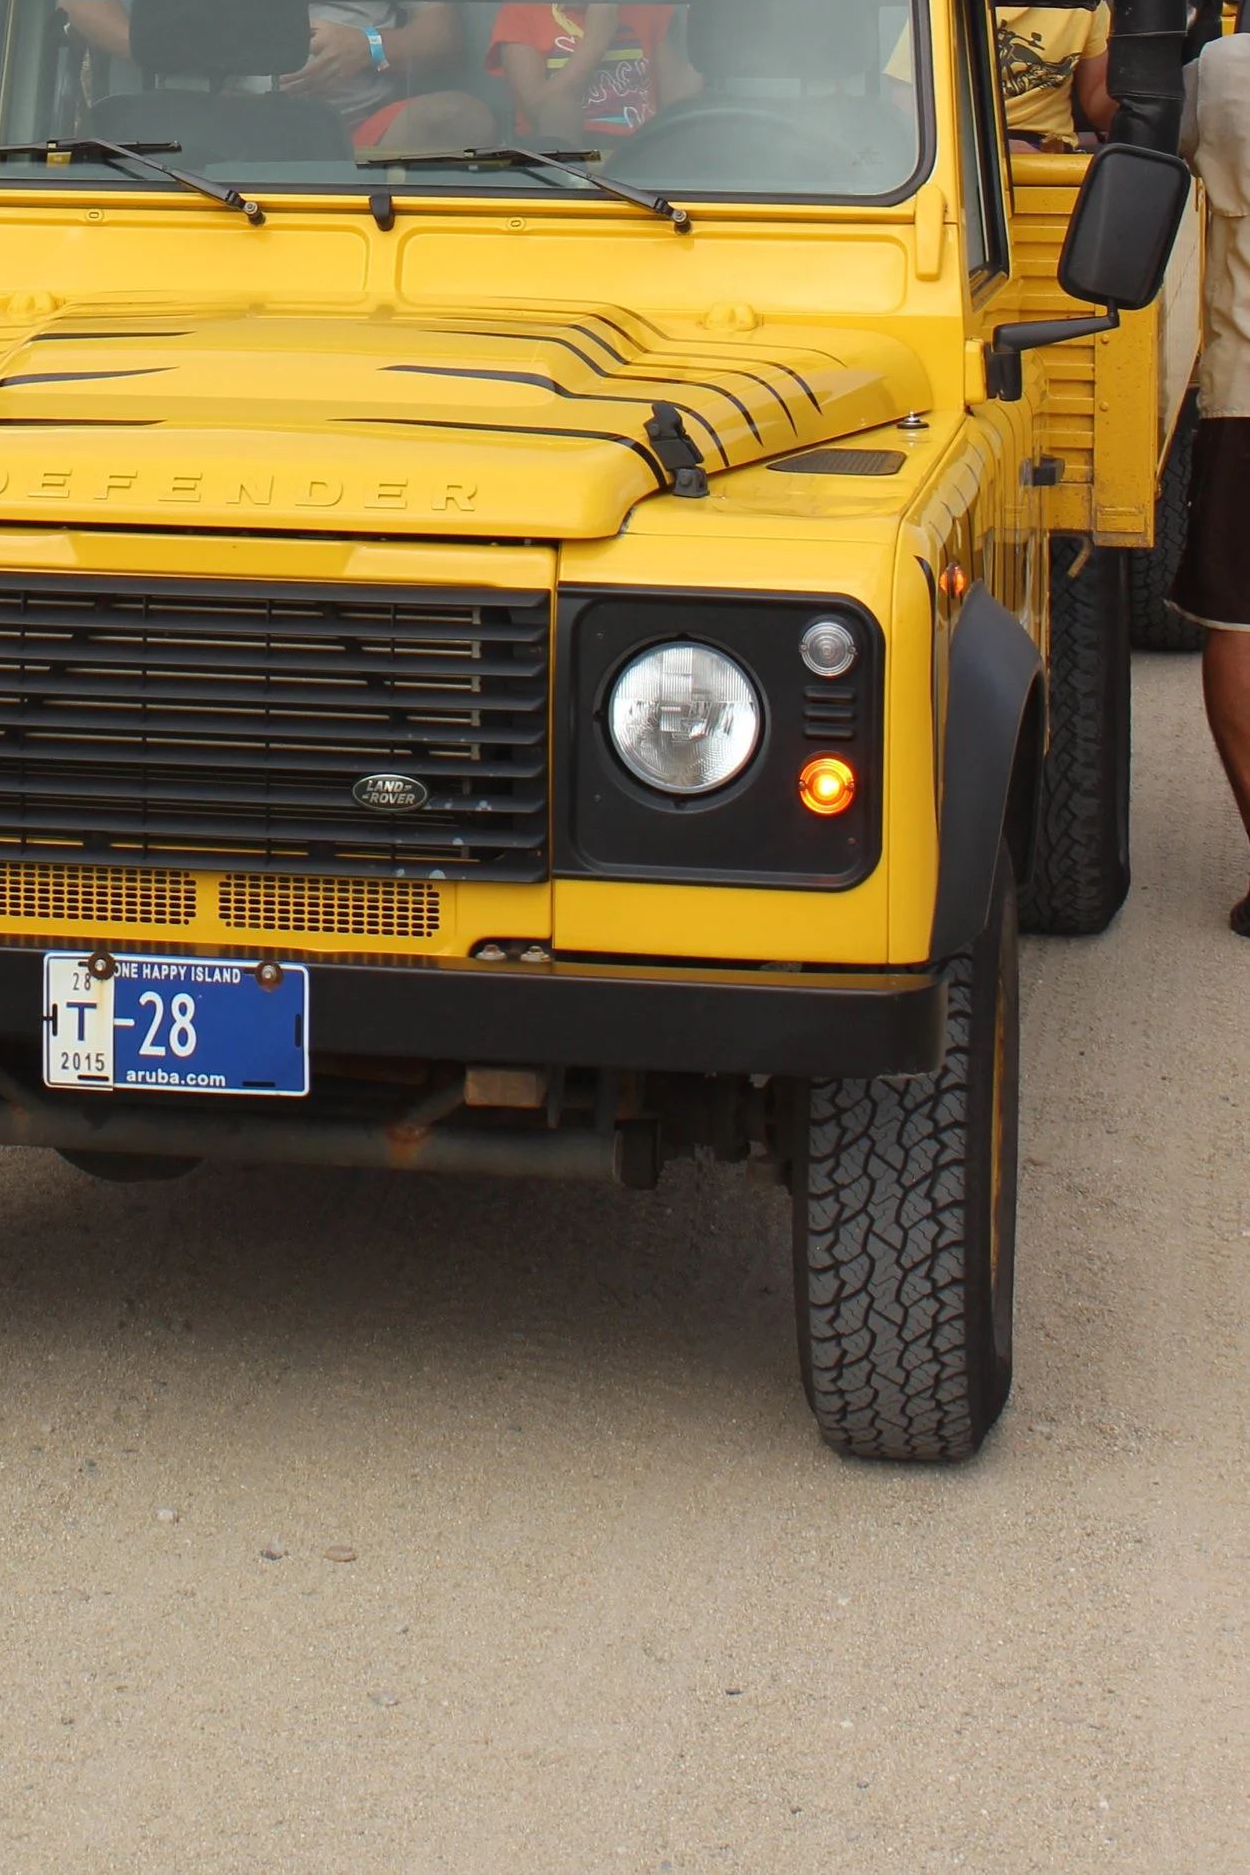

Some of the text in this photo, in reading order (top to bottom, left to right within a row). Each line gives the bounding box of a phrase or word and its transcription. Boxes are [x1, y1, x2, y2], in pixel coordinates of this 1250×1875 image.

[366, 780, 404, 792] LAND
[370, 792, 415, 804] ROVER
[72, 972, 91, 991] 28
[142, 964, 187, 981] HAPPY
[191, 966, 241, 984] ISLAND
[66, 1002, 97, 1041] T
[60, 1051, 105, 1072] 2015
[126, 1068, 226, 1088] aruba.com
